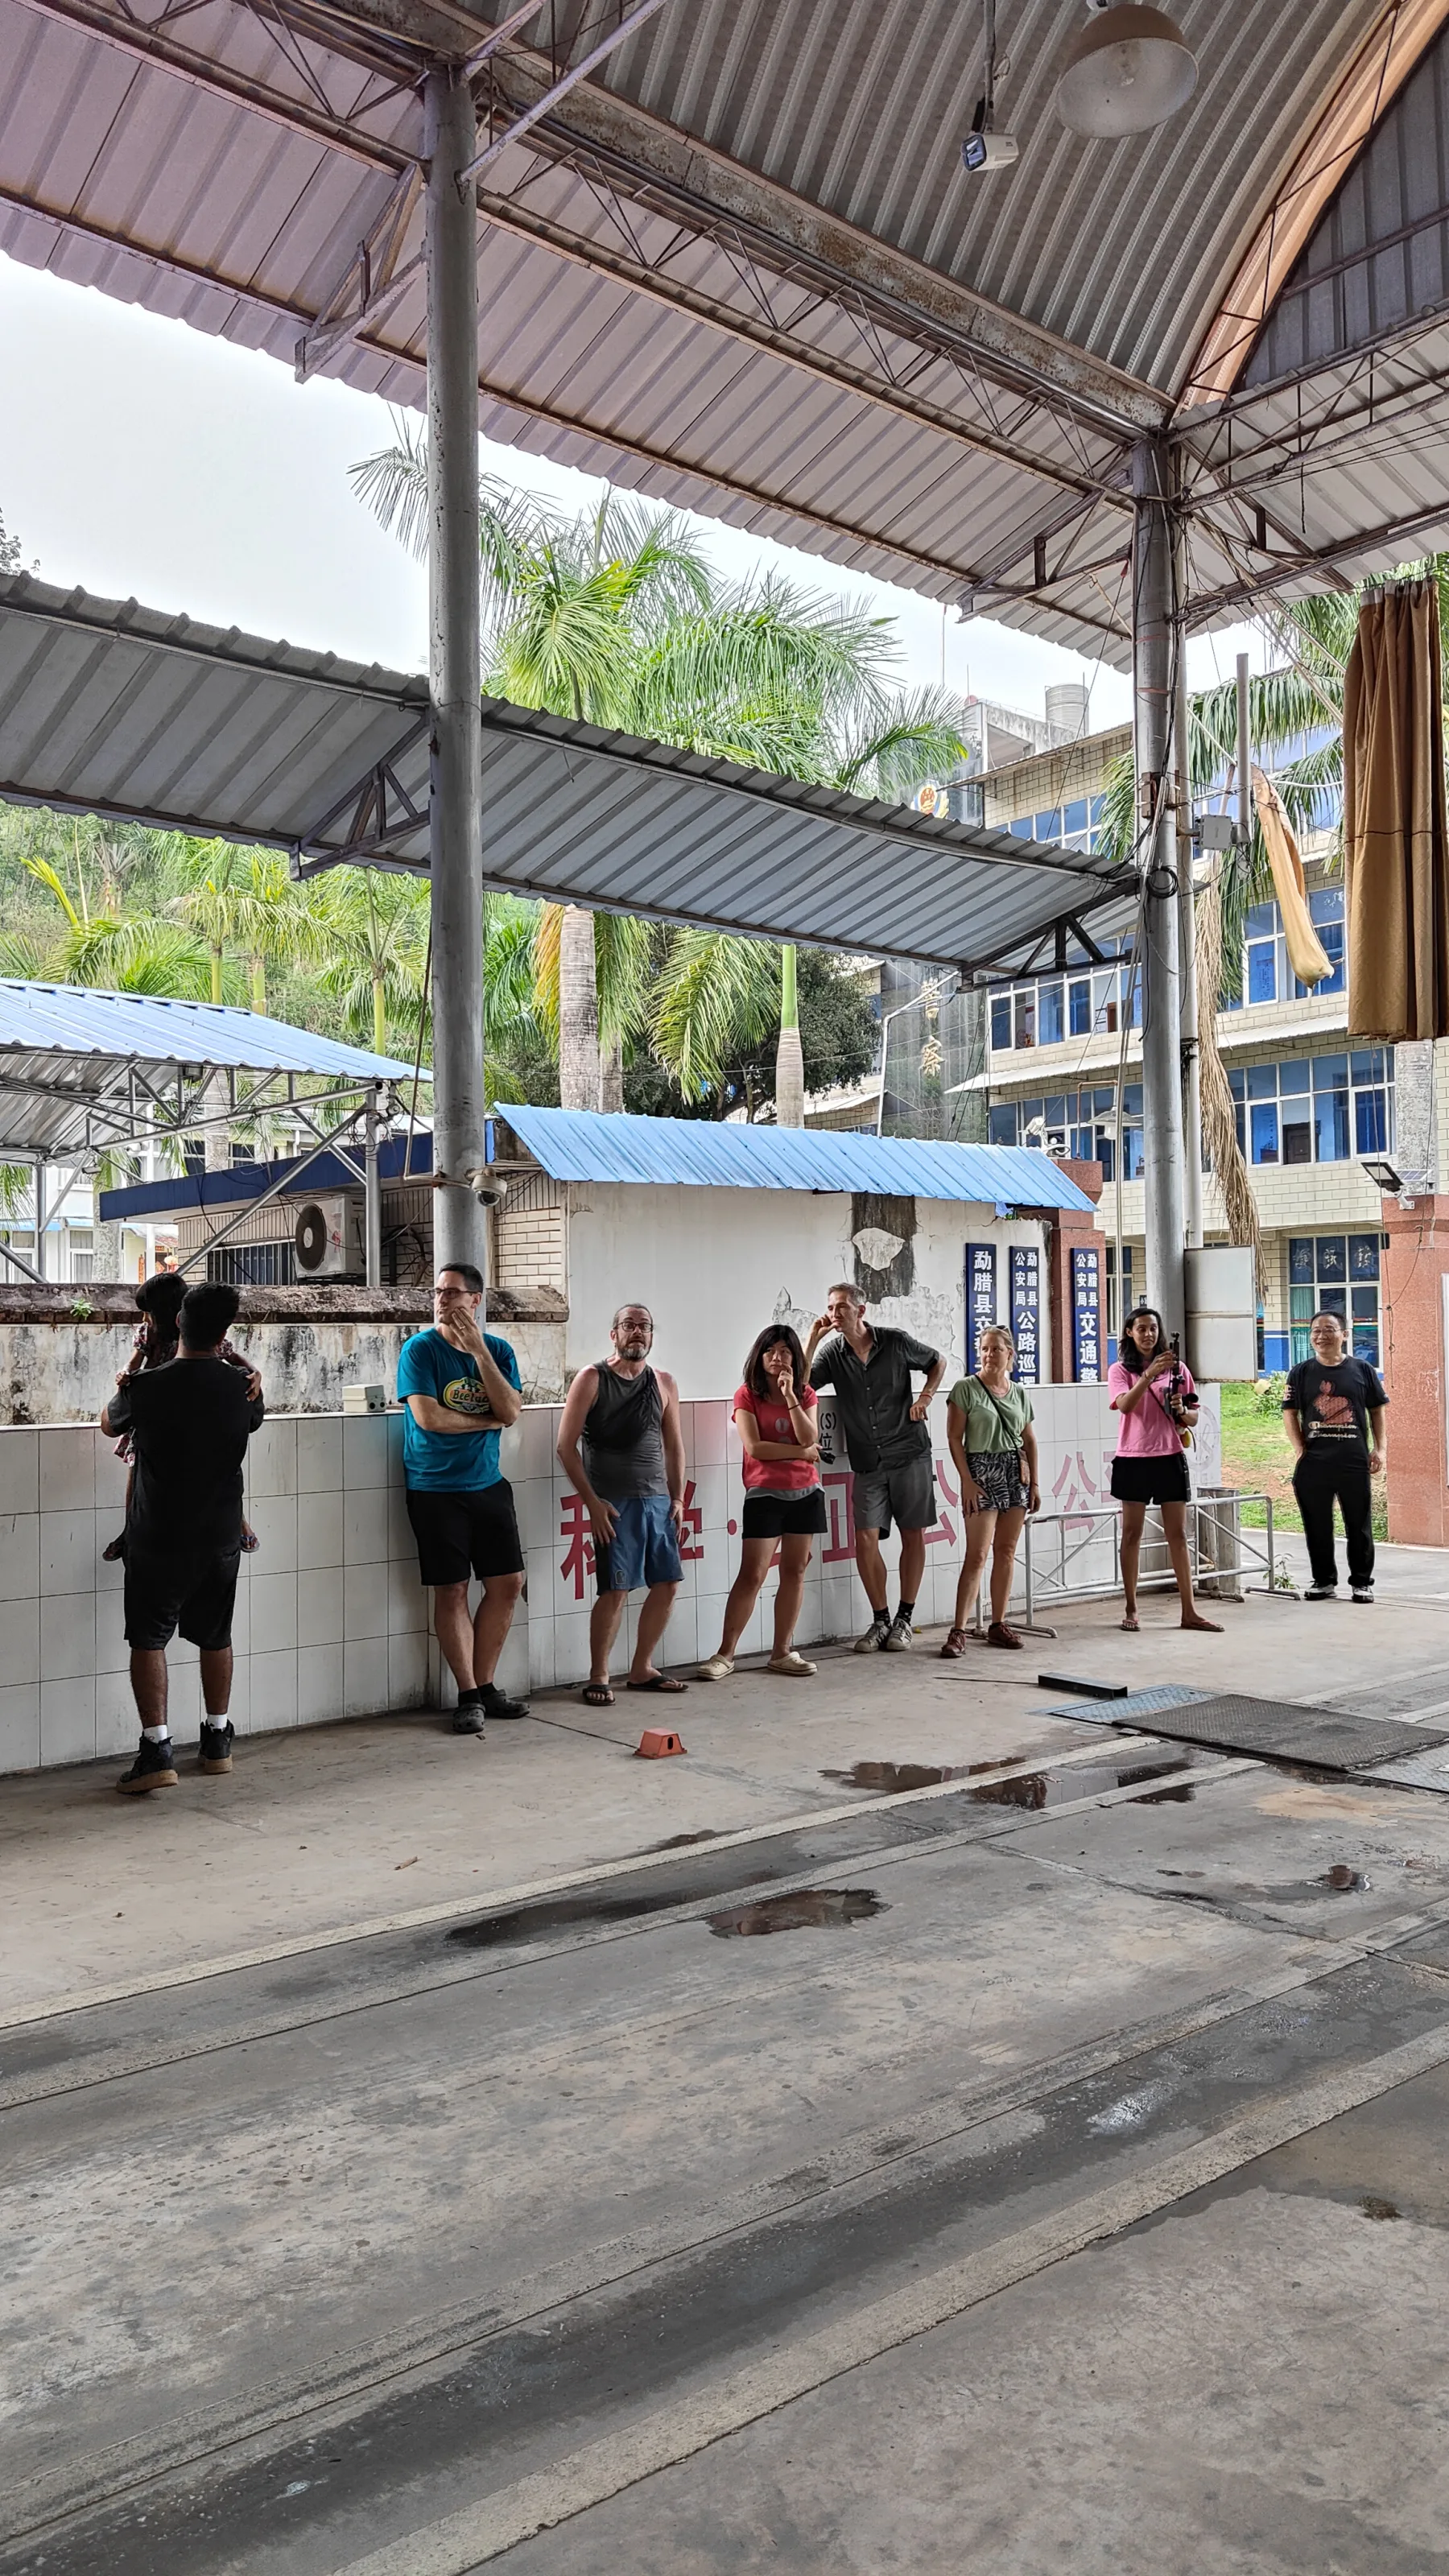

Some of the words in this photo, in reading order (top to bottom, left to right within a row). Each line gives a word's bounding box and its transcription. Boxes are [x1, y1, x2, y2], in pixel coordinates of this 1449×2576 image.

[1014, 1252, 1026, 1307] 公安局
[1026, 1252, 1038, 1307] 勐腊县
[1075, 1253, 1088, 1307] 公安局
[1087, 1253, 1099, 1307] 勐腊县
[973, 1250, 993, 1369] 勐腊县交
[820, 1412, 837, 1430] (S)
[1308, 1421, 1358, 1431] Champion
[1308, 1430, 1358, 1441] Champion
